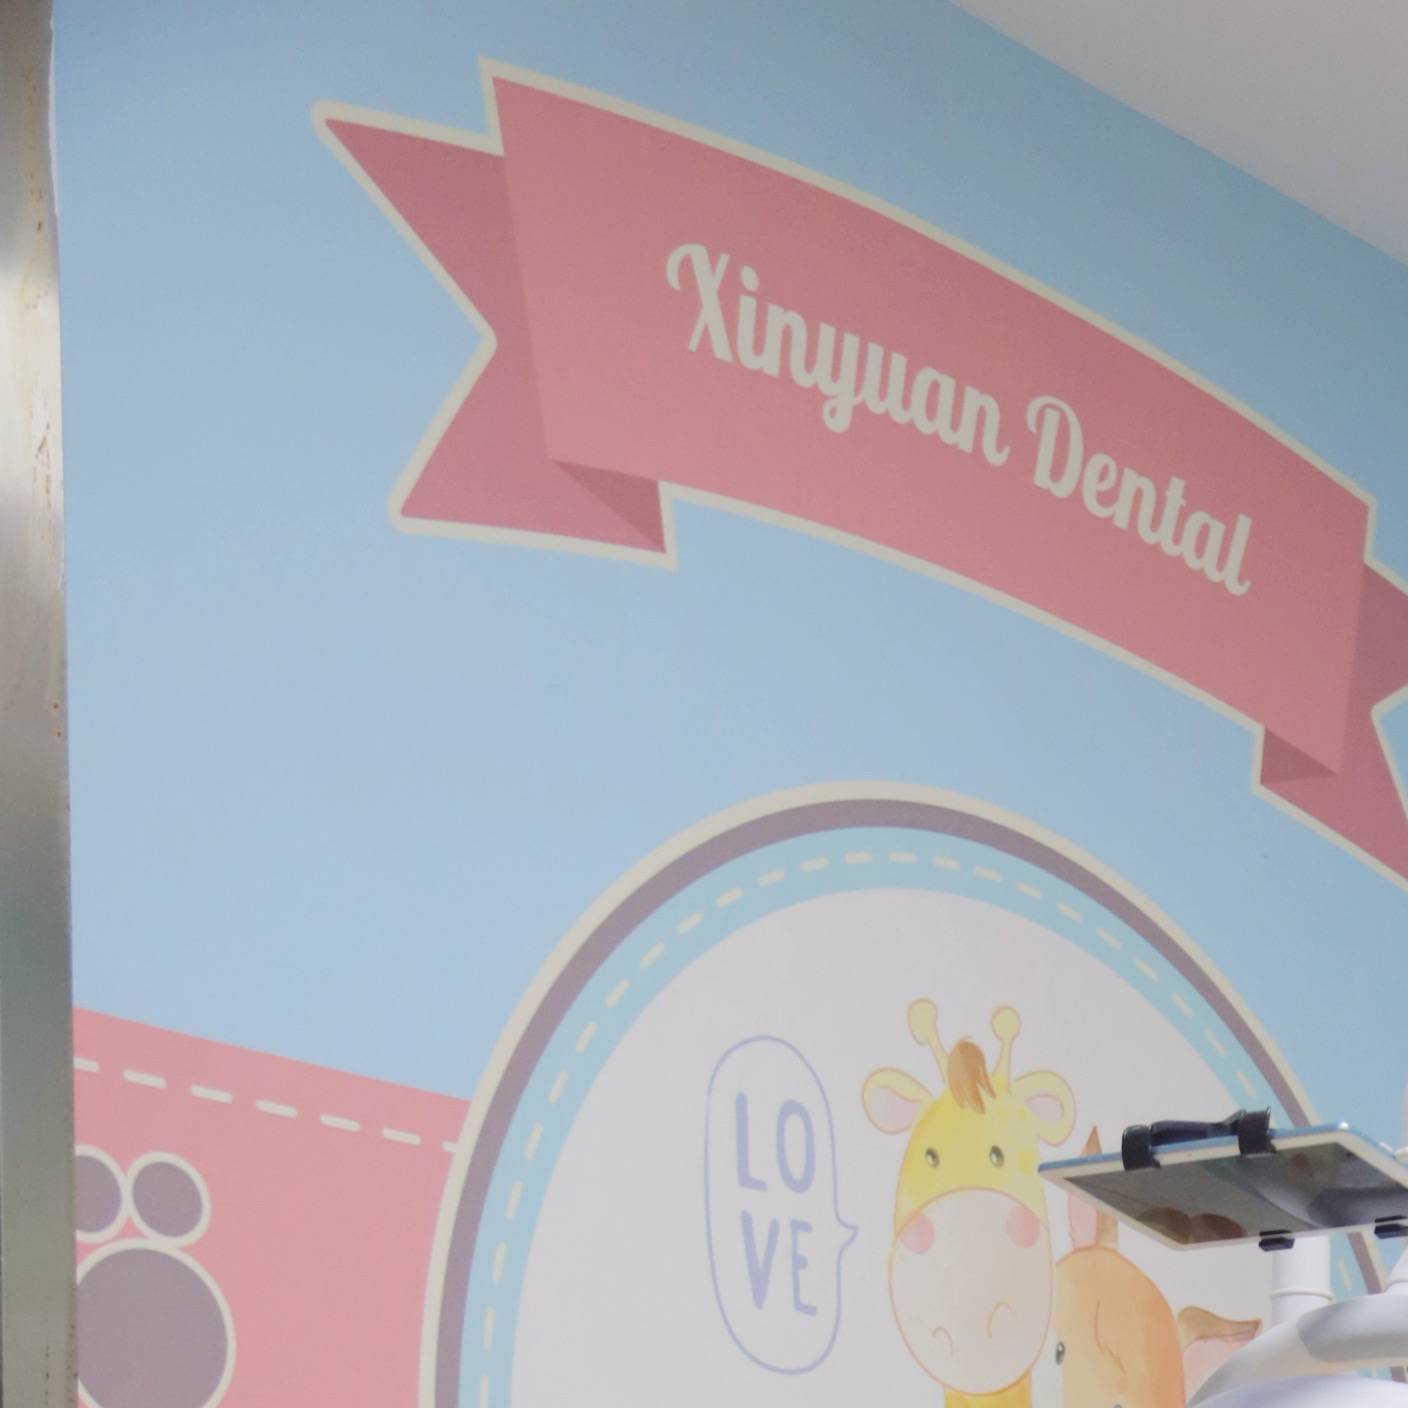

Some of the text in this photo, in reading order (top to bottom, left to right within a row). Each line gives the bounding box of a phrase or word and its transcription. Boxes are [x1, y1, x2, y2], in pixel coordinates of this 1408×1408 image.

[665, 243, 1254, 596] Xinyuan Dental
[734, 1092, 816, 1195] LO
[740, 1209, 819, 1318] VE
